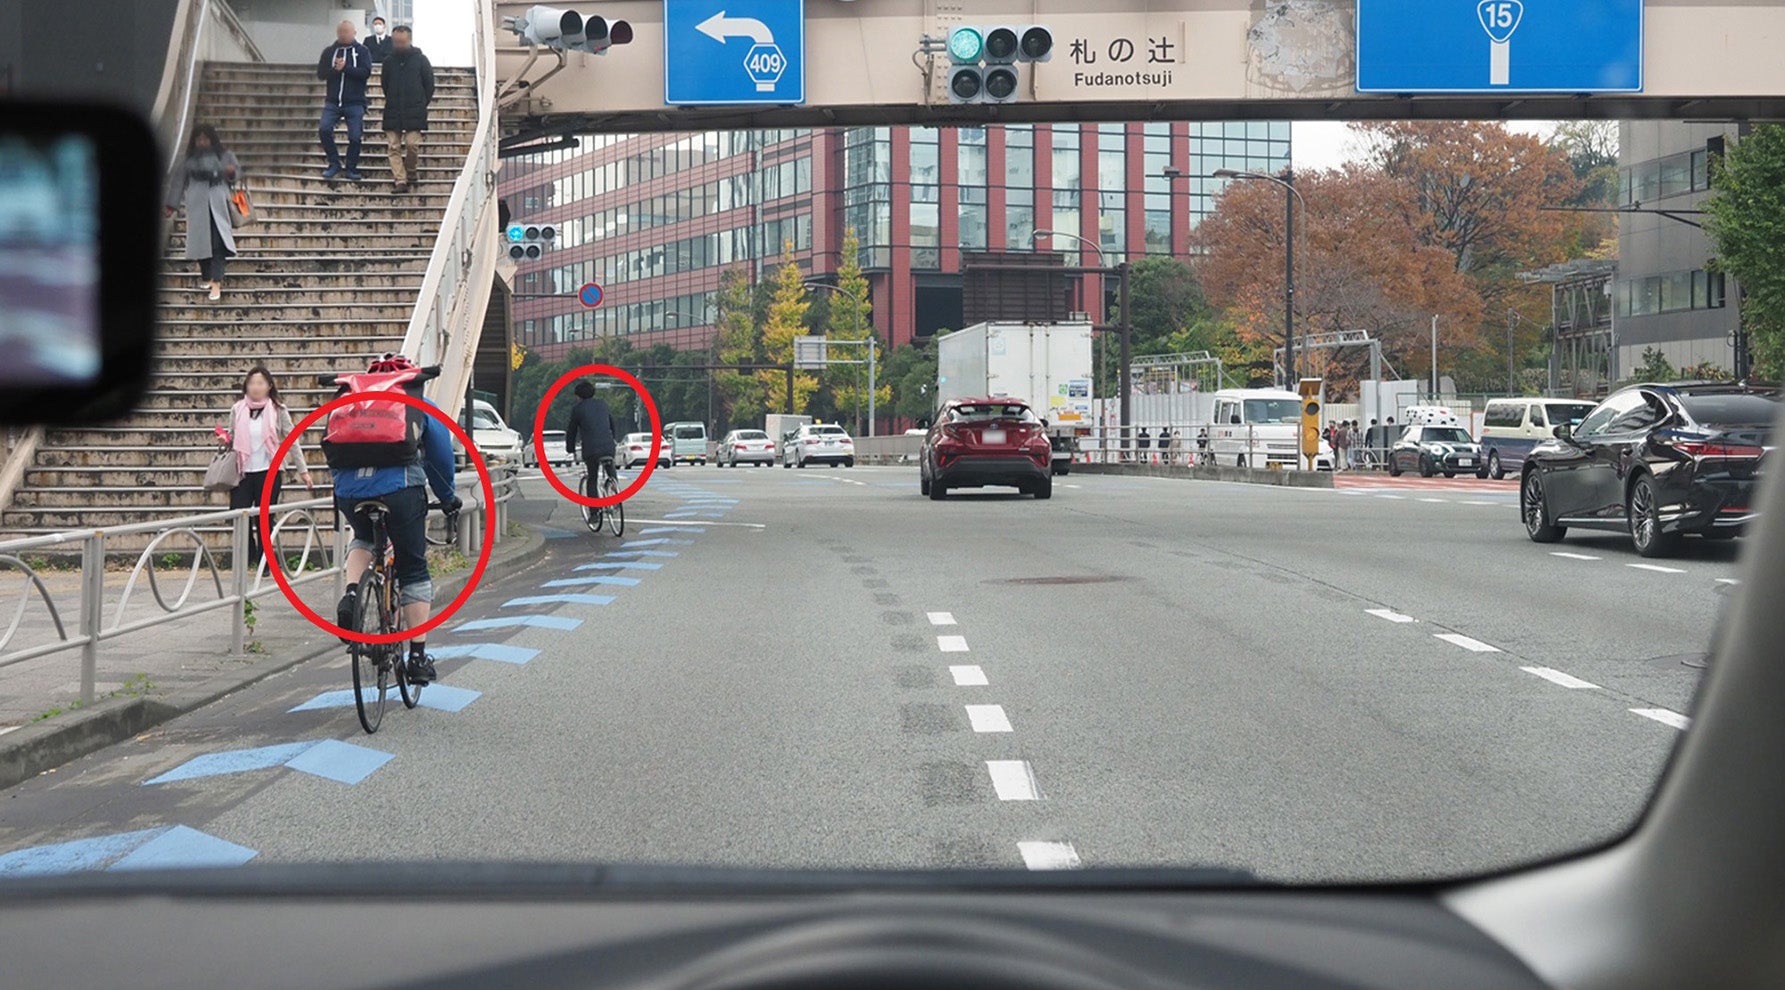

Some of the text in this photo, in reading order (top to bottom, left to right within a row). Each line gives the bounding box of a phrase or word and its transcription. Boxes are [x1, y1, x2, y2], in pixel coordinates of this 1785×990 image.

[1485, 3, 1513, 28] 15
[1070, 36, 1175, 64] 札の辻
[750, 53, 780, 73] 409
[1075, 71, 1172, 87] Fudanotsuji
